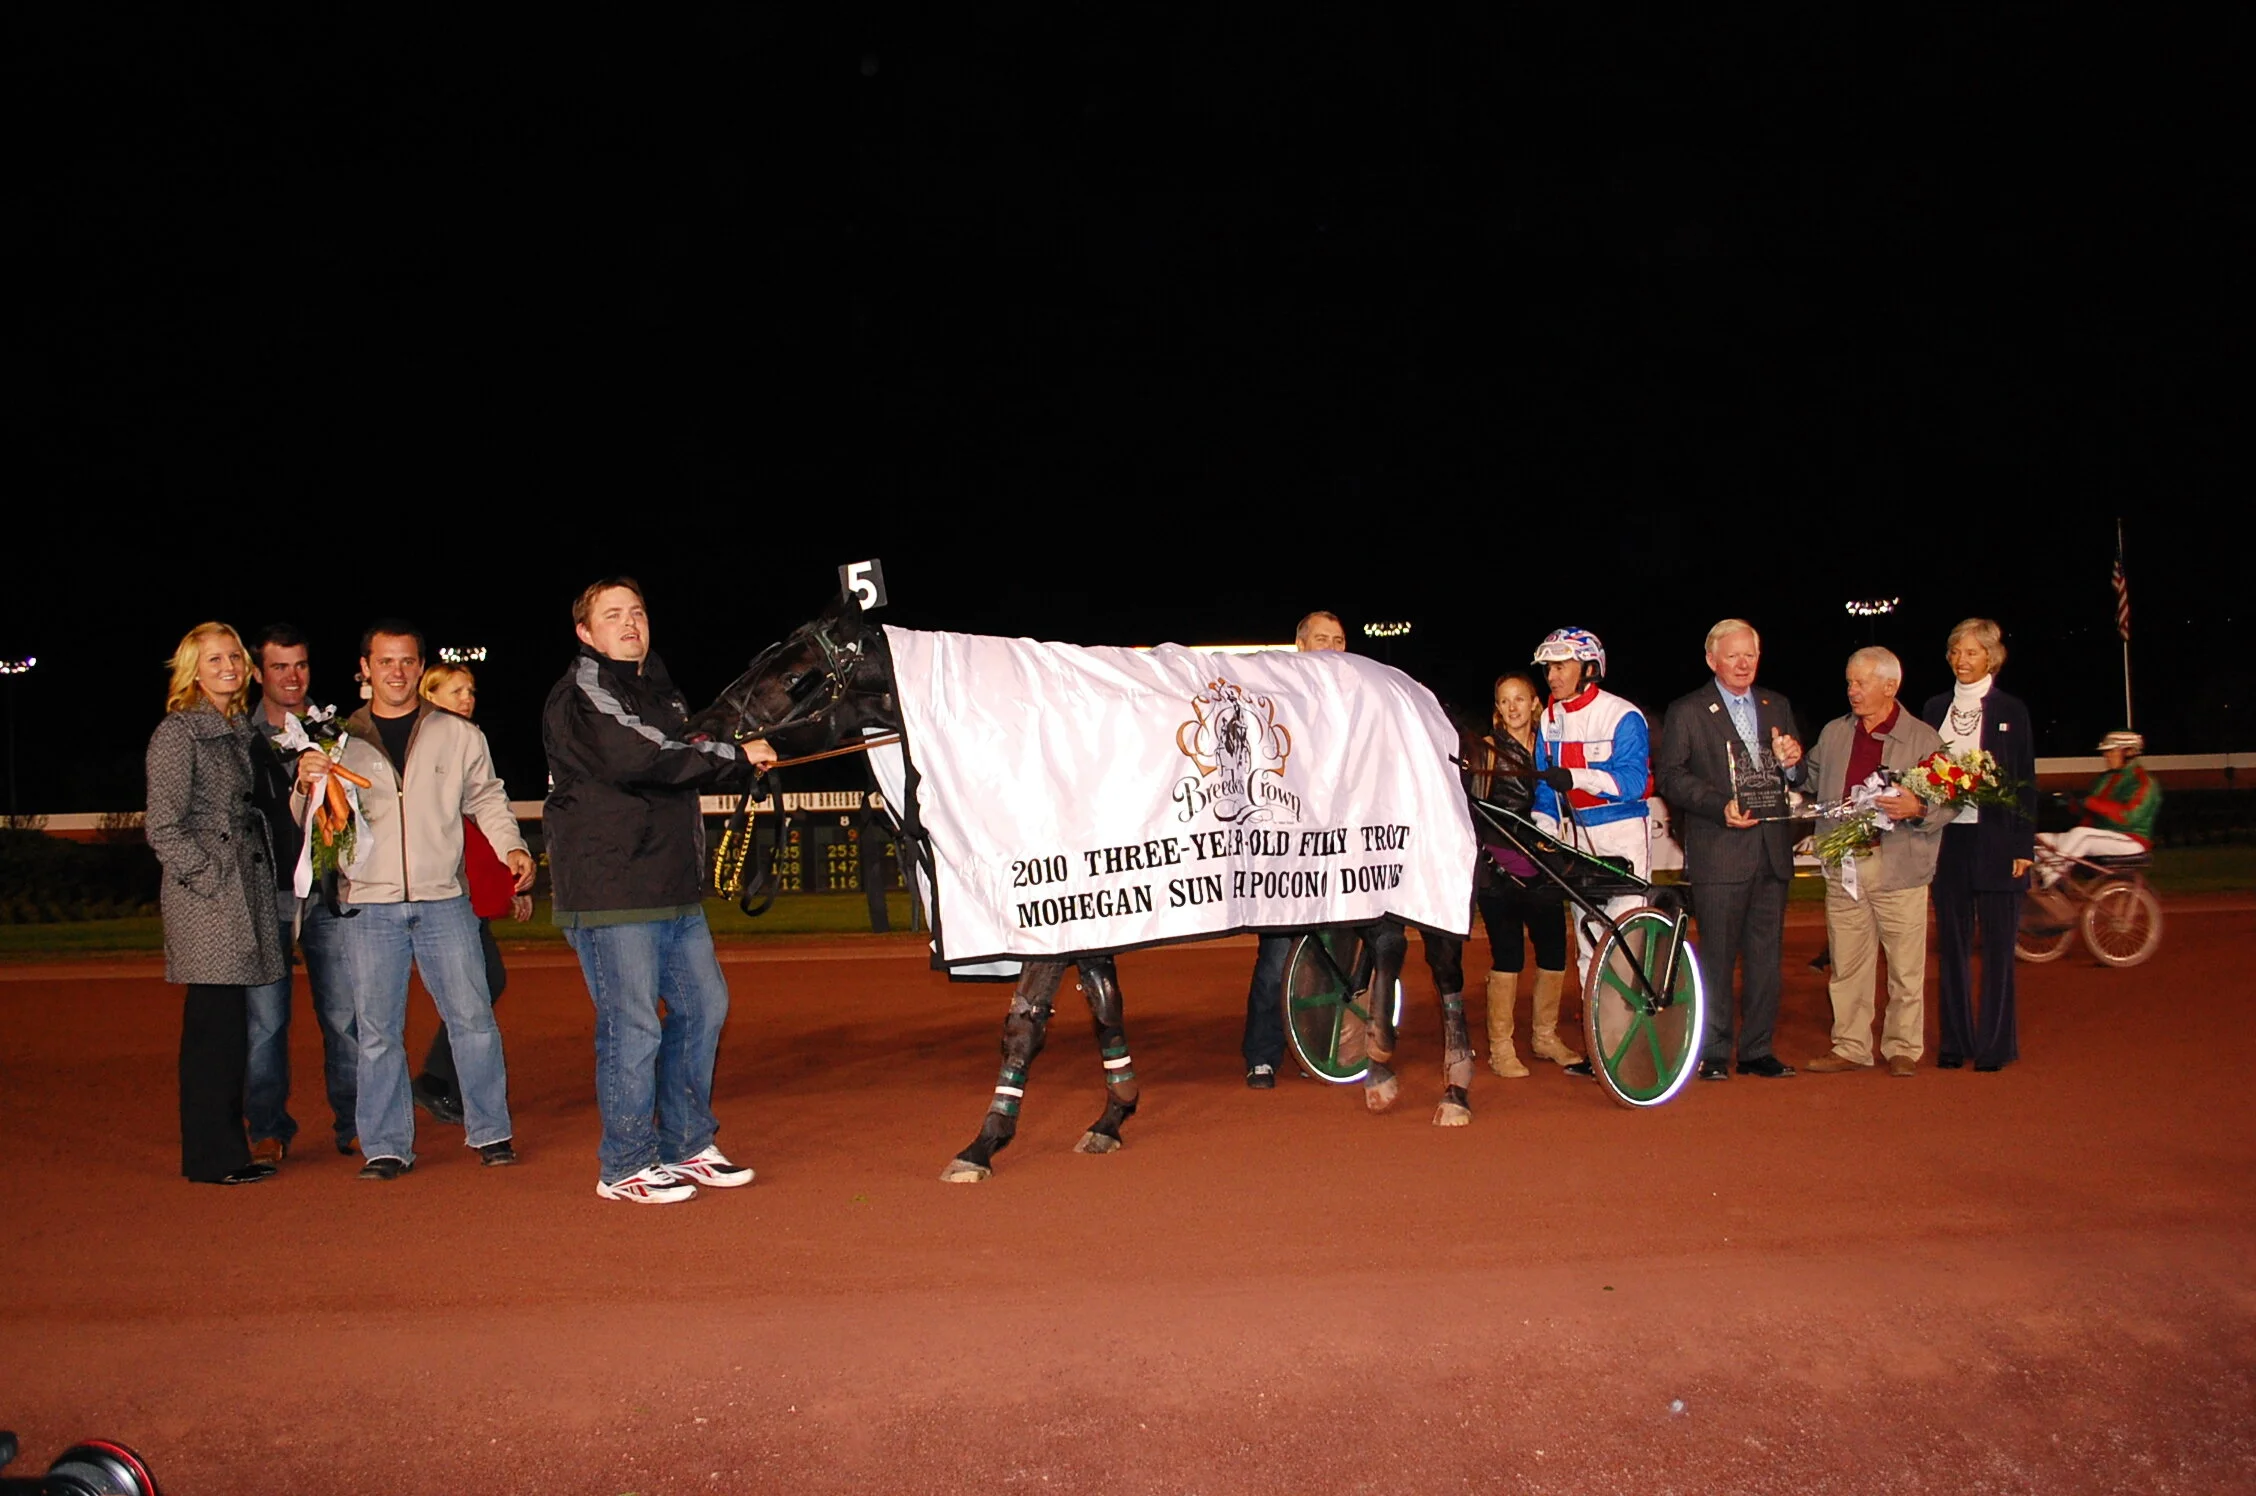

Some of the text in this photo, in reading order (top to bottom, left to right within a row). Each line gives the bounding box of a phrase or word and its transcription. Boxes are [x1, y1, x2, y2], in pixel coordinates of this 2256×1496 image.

[847, 560, 878, 612] 5
[1247, 768, 1301, 823] Crown
[839, 815, 850, 827] 8
[827, 845, 858, 859] 253
[828, 860, 858, 874] 147
[1011, 855, 1068, 888] 2010
[1361, 823, 1410, 852] TROT
[829, 875, 858, 890] 116
[1016, 884, 1153, 928] MOHEGAN
[1168, 874, 1224, 908] SUN
[1250, 871, 1327, 898] POCONO
